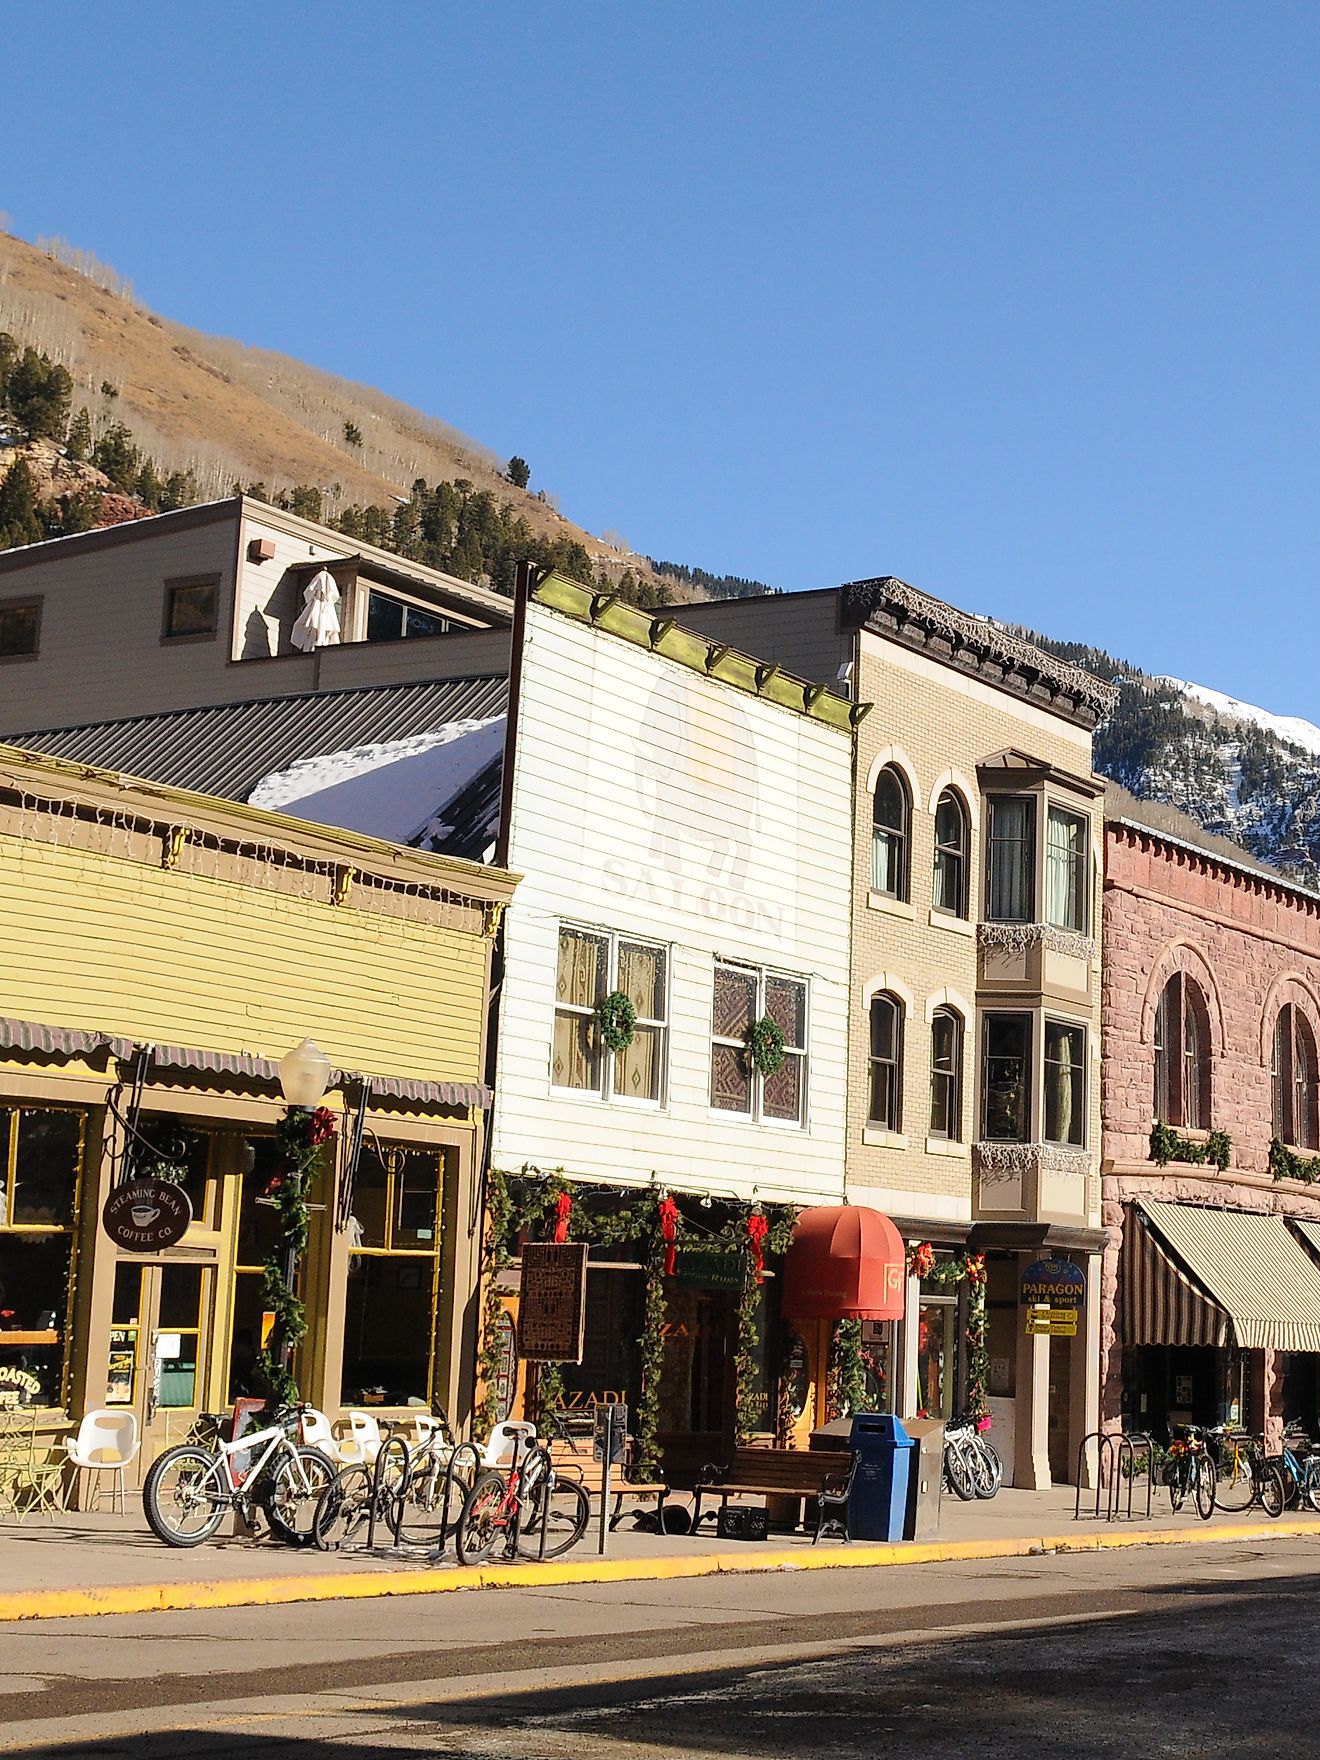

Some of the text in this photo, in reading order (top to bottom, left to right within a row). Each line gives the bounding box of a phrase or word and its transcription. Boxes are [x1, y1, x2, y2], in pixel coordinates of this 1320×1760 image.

[601, 857, 787, 945] SALOON
[110, 1188, 181, 1216] STEAMING BEAN
[117, 1225, 154, 1242] COFFEE
[1022, 1284, 1083, 1295] PARAGON
[1028, 1295, 1077, 1305] ski & sport
[551, 1391, 628, 1411] AZADI
